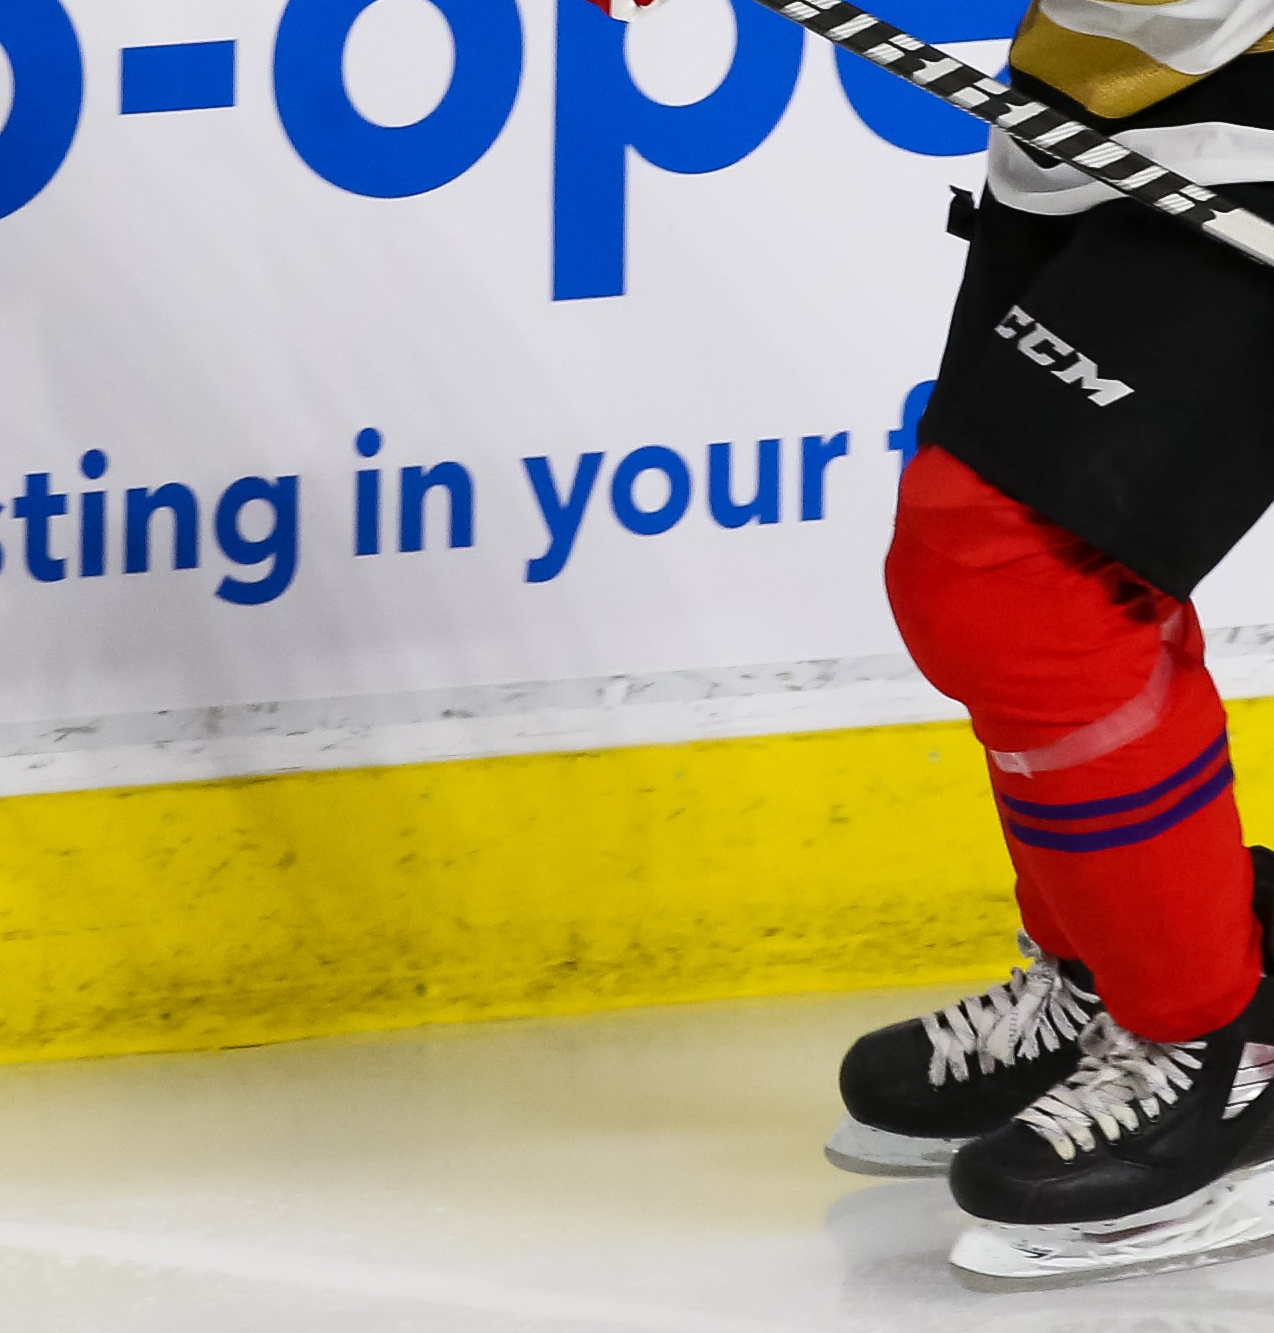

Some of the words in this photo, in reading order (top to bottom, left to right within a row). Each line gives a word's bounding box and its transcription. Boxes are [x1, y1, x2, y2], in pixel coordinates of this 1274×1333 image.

[994, 304, 1135, 407] CCM
[356, 427, 474, 554] in
[523, 431, 849, 583] your
